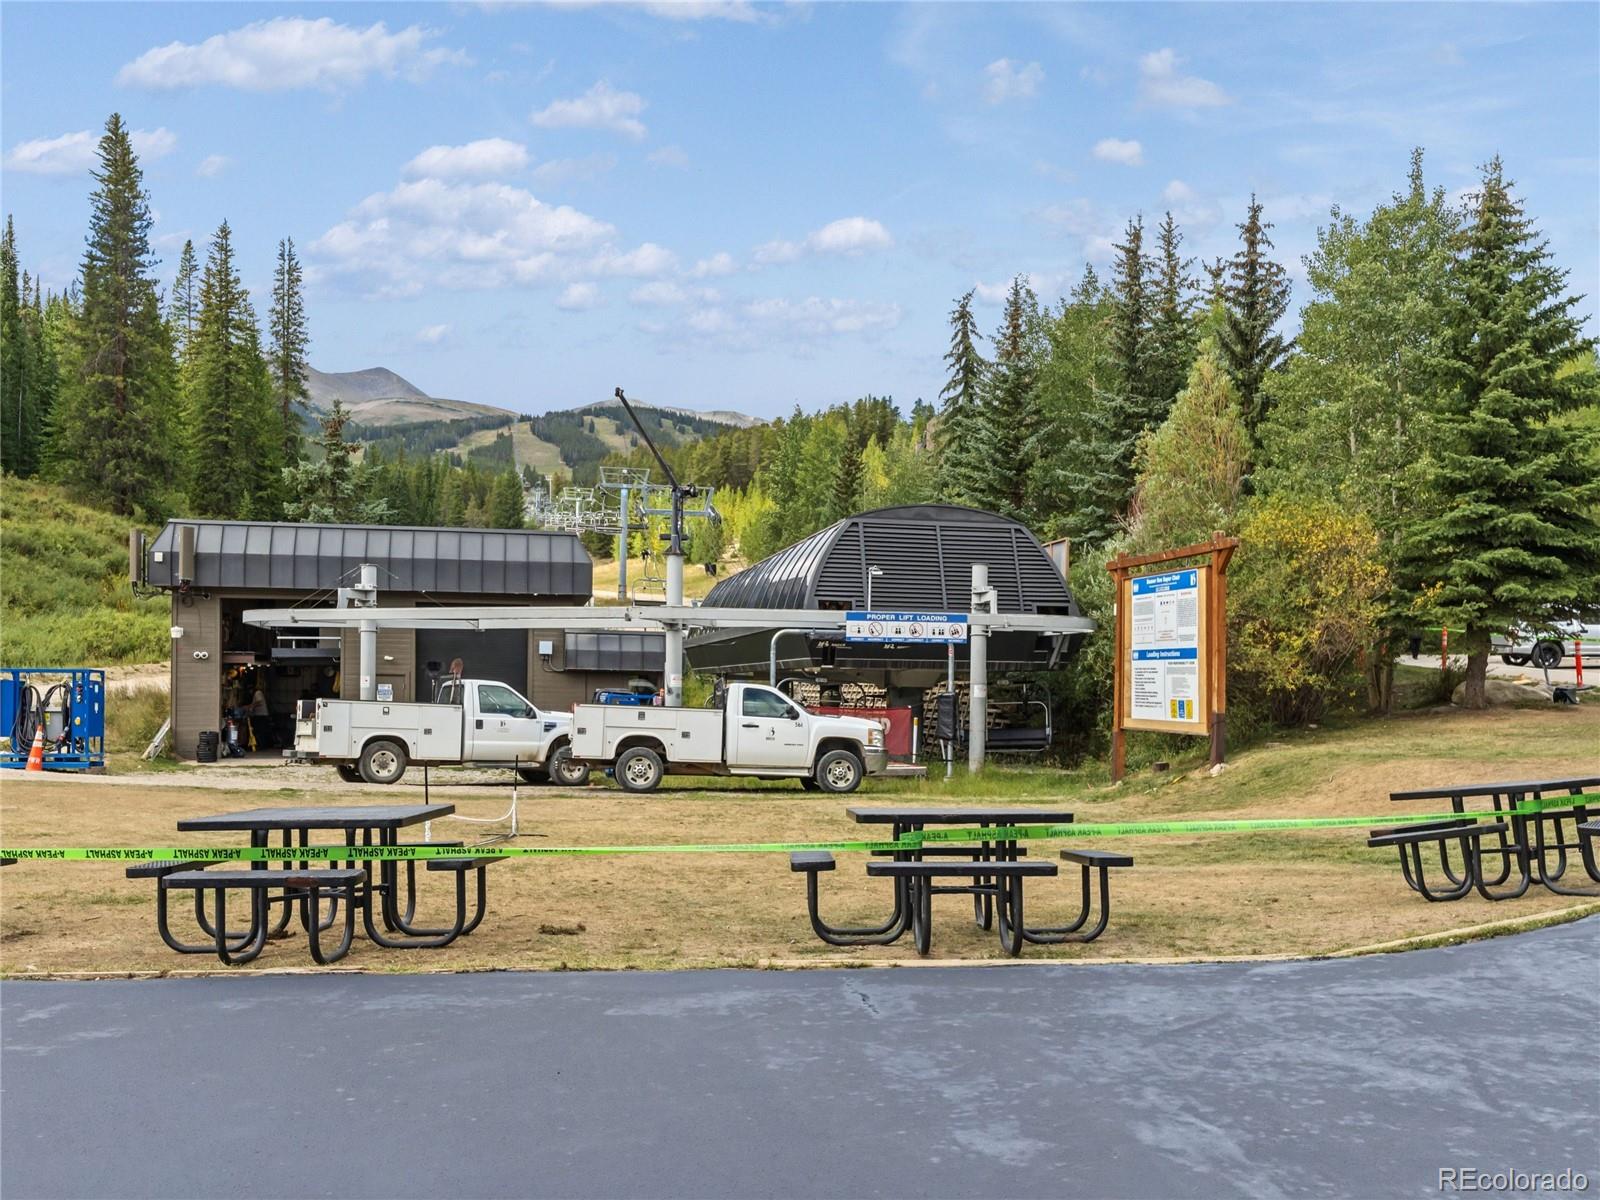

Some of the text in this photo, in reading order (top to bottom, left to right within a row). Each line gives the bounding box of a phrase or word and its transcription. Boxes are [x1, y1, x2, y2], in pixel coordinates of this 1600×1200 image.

[0, 849, 65, 858] A-PEAK ASPHAL
[85, 849, 153, 858] A-PEAK ASPHALT
[173, 849, 241, 858] A-PEAK ASPHALT
[260, 848, 329, 858] A-PEAK ASPHALT
[348, 847, 416, 857] A-PEAK ASPHALT
